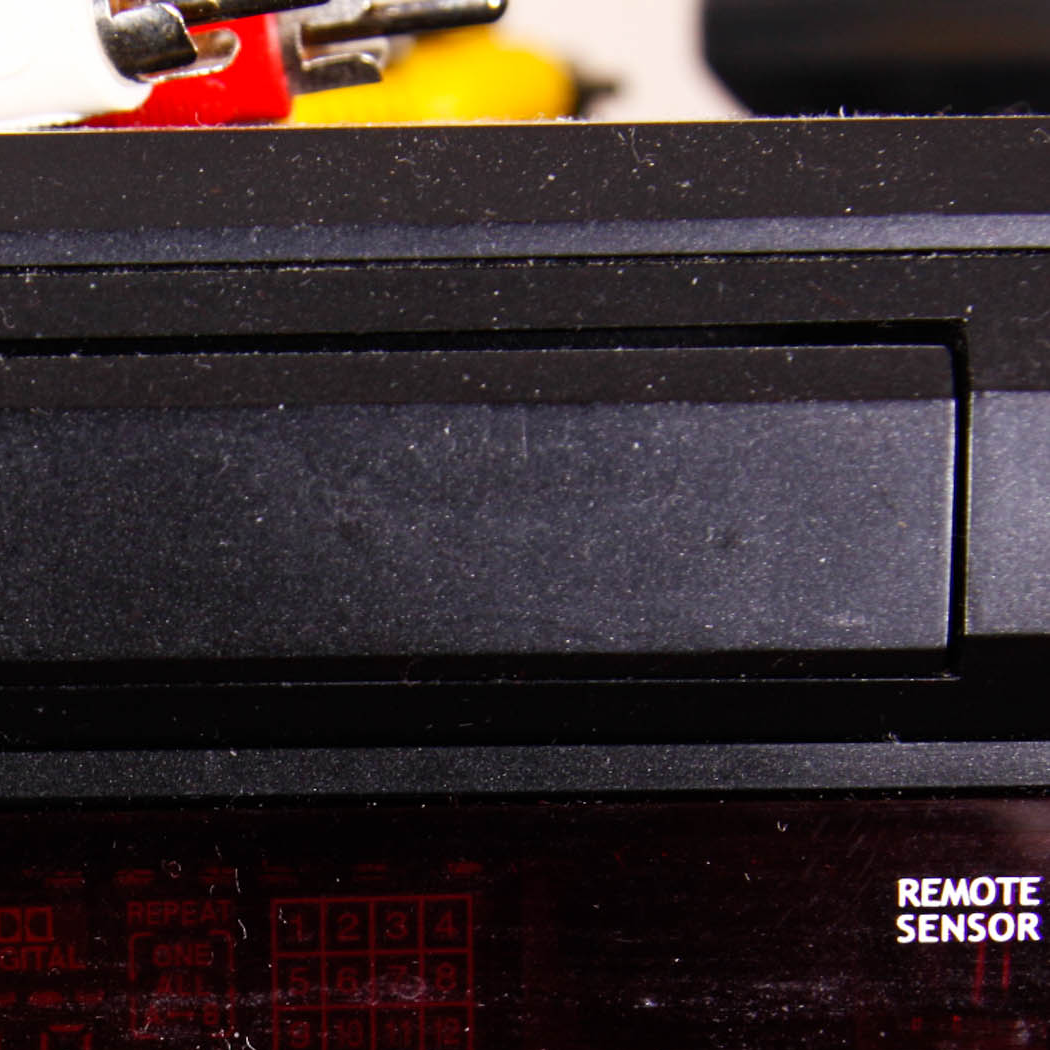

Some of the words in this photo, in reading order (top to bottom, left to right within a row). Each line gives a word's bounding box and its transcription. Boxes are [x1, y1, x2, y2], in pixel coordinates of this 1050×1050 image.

[896, 877, 1040, 908] REMOTE
[126, 900, 231, 926] REPEAT
[287, 912, 304, 943] 1
[336, 912, 361, 942] 2
[386, 911, 409, 940] 3
[434, 911, 458, 937] 4
[896, 912, 1041, 944] SENSOR
[152, 942, 213, 967] ONE
[157, 974, 205, 996] ALL
[288, 967, 310, 998] 5
[336, 966, 358, 995] 6
[434, 962, 457, 993] 8
[286, 1020, 311, 1049] 9
[334, 1018, 364, 1048] 10
[386, 1018, 412, 1047] 11
[434, 1018, 461, 1047] 12
